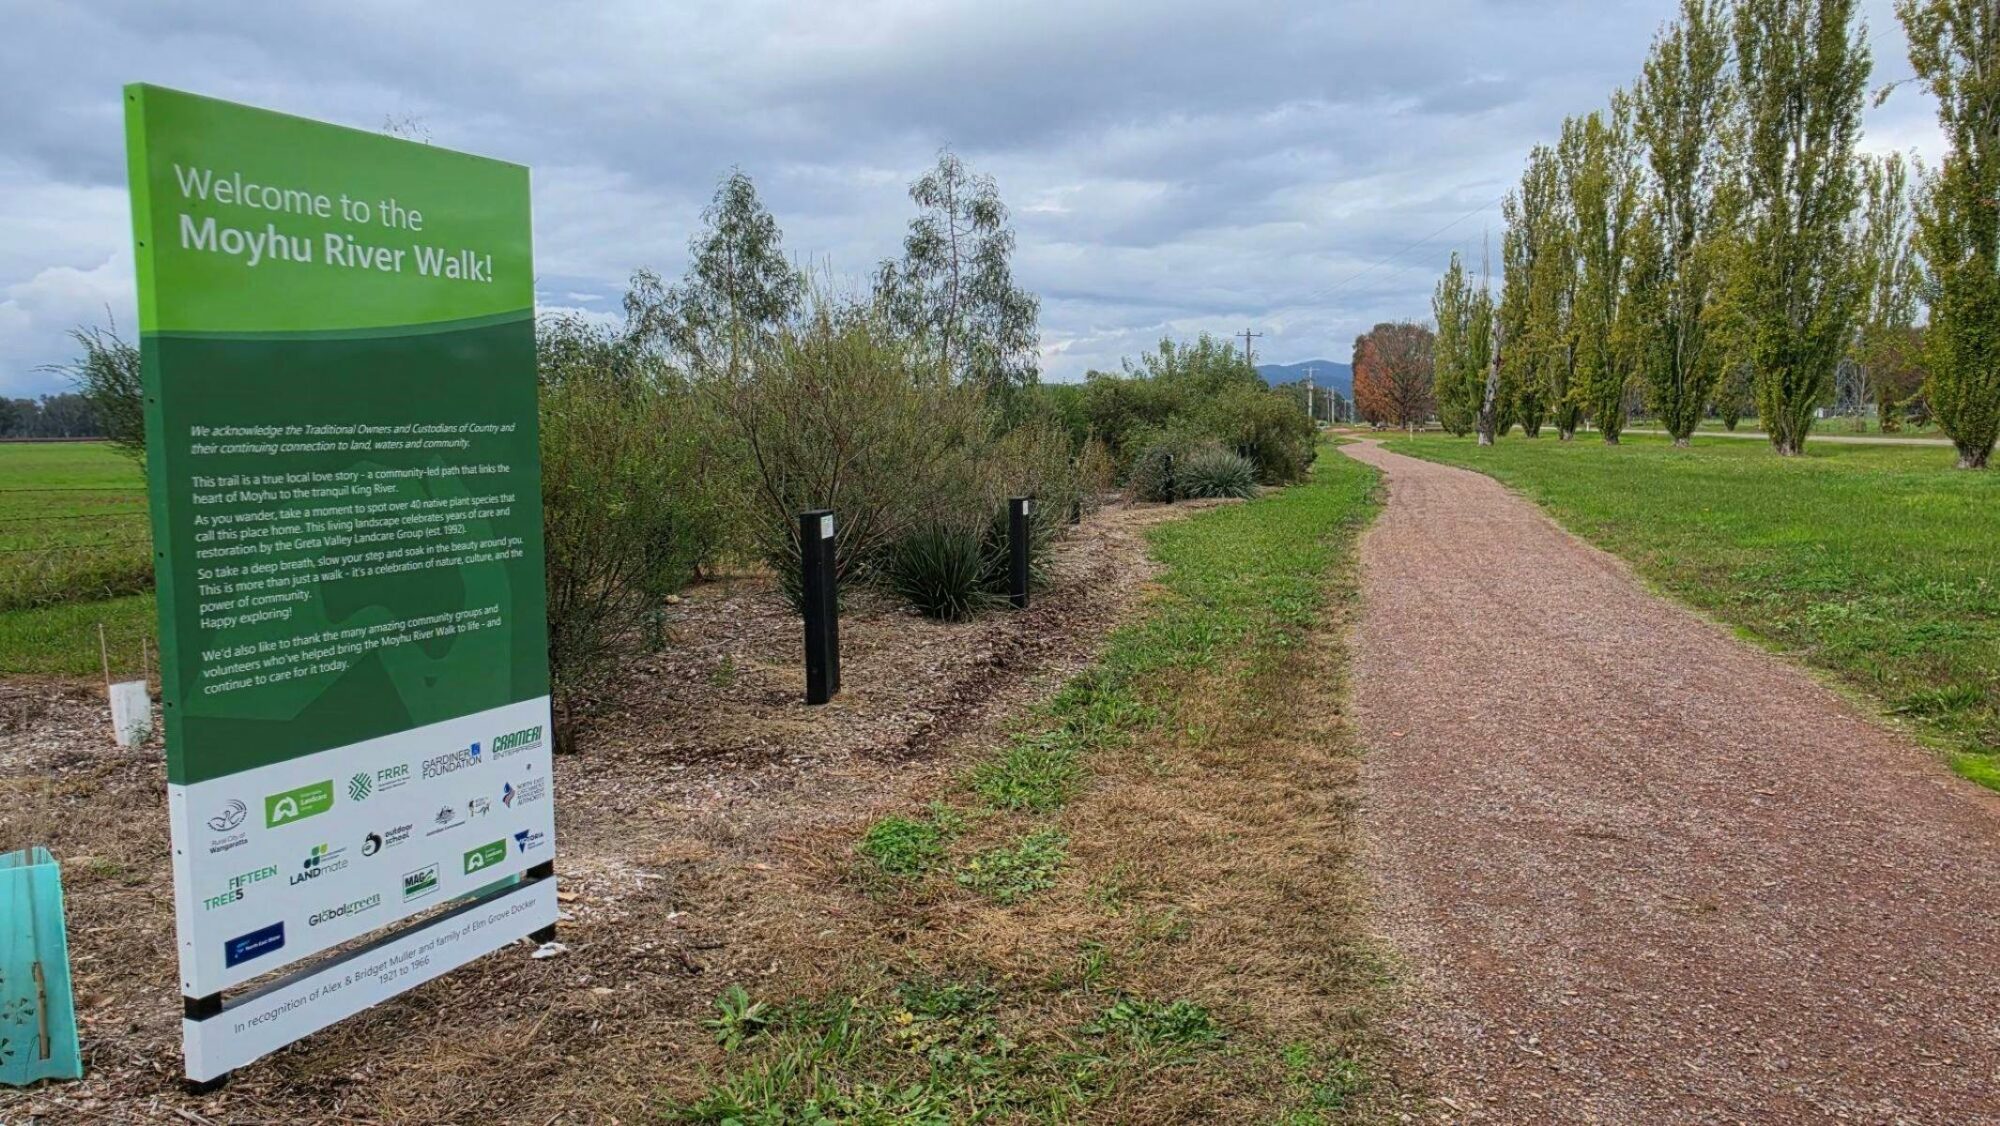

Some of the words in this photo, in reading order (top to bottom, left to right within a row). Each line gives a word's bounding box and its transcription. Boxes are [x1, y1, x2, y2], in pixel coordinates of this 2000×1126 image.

[173, 164, 330, 218] Welcome
[340, 194, 370, 224] to
[380, 198, 422, 232] the
[179, 214, 312, 267] Moyhu
[325, 234, 406, 272] River
[414, 245, 492, 282] Walk!
[192, 476, 215, 487] This
[218, 474, 240, 486] trail
[242, 474, 250, 485] is
[253, 476, 260, 484] a
[263, 474, 284, 484] true
[286, 472, 310, 483] local
[312, 471, 333, 482] love
[335, 471, 358, 482] story
[375, 466, 440, 479] community-led
[442, 465, 460, 478] path
[462, 465, 477, 474] that
[479, 464, 496, 474] links
[498, 463, 510, 473] the
[195, 514, 209, 525] As
[211, 514, 232, 526] you
[235, 510, 277, 522] wander,
[280, 508, 301, 519] take
[312, 505, 353, 516] moment
[355, 504, 365, 513] to
[367, 502, 387, 514] spot
[389, 502, 408, 511] over
[410, 499, 421, 509] 40
[423, 498, 447, 508] native
[450, 497, 470, 509] plant
[471, 494, 498, 507] species
[500, 493, 515, 502] that
[195, 530, 214, 542] call
[217, 528, 238, 540] this
[240, 527, 268, 540] place
[270, 525, 303, 535] home.
[305, 521, 325, 532] This
[328, 520, 353, 531] living
[355, 517, 399, 528] landscape
[402, 513, 444, 524] celebrates
[446, 512, 466, 523] years
[468, 509, 477, 519] of
[496, 507, 510, 516] and
[196, 544, 257, 558] restoration
[259, 542, 272, 554] by
[275, 540, 292, 551] the
[294, 538, 321, 549] Greta
[323, 535, 352, 547] Valley
[354, 532, 394, 544] Landcare
[397, 530, 423, 540] Group
[426, 528, 444, 540] (est.
[444, 525, 466, 536] 1992).
[197, 568, 213, 579] So
[215, 565, 239, 577] take
[241, 566, 248, 574] a
[251, 563, 278, 574] deep
[280, 557, 315, 570] breath,
[318, 555, 340, 566] slow
[342, 554, 364, 566] your
[365, 551, 384, 562] step
[386, 548, 403, 558] and
[405, 546, 424, 556] soak
[426, 545, 434, 554] in
[436, 543, 449, 553] the
[451, 541, 477, 551] beauty
[479, 537, 506, 548] around
[508, 538, 522, 548] you.
[198, 584, 222, 596] This
[224, 582, 233, 593] is
[236, 580, 264, 591] more
[266, 576, 290, 587] than
[292, 573, 311, 587] just
[321, 569, 343, 581] walk
[352, 567, 365, 577] it's
[375, 561, 423, 574] celebration
[426, 558, 435, 568] of
[436, 558, 463, 567] nature,
[466, 554, 493, 563] culture,
[495, 550, 509, 560] and
[511, 549, 523, 558] the
[200, 600, 235, 615] power
[238, 596, 250, 608] of
[252, 591, 312, 606] community.
[201, 616, 237, 629] Happy
[239, 607, 292, 624] exploring!
[202, 647, 231, 661] We'd
[234, 645, 256, 656] also
[259, 640, 276, 652] like
[279, 639, 290, 648] to
[293, 632, 321, 646] thank
[323, 630, 339, 641] the
[341, 627, 366, 638] many
[369, 621, 405, 634] amazing
[407, 613, 453, 627] community
[456, 608, 482, 621] groups
[484, 604, 499, 614] and
[203, 660, 260, 677] volunteers
[263, 653, 300, 666] who've
[302, 645, 335, 660] helped
[337, 642, 361, 654] bring
[364, 638, 379, 649] the
[381, 633, 411, 646] Moyhu
[414, 630, 434, 640] River
[436, 625, 455, 636] Walk
[458, 624, 465, 633] to
[467, 621, 479, 631] life
[487, 617, 501, 627] and
[204, 678, 252, 694] continue
[256, 675, 266, 685] to
[269, 671, 291, 682] care
[294, 667, 307, 678] for
[310, 664, 317, 675] it
[320, 661, 349, 672] today.
[493, 726, 542, 752] CRAMERI
[378, 764, 408, 781] FRRR
[422, 749, 470, 770] GARDINER
[422, 757, 481, 779] FOUNDATION
[385, 824, 412, 837] outdoor
[386, 832, 409, 844] school
[210, 838, 248, 853] Wangaratta
[229, 864, 278, 890] FIFTEEN
[290, 859, 348, 885] LANDmate
[405, 872, 426, 886] MAG
[234, 1022, 245, 1033] In
[247, 997, 306, 1028] recognition
[310, 989, 320, 1001] of
[322, 982, 342, 996] Alex
[345, 976, 352, 985] &
[355, 961, 387, 982] Bridget
[390, 950, 416, 967] Muller
[418, 940, 434, 954] and
[436, 931, 460, 947] family
[463, 925, 470, 935] of
[473, 920, 486, 931] Elm
[488, 910, 509, 924] Grove
[511, 899, 536, 914] Docker
[378, 969, 397, 984] 1921
[400, 966, 409, 975] to
[412, 955, 430, 970] 1966
